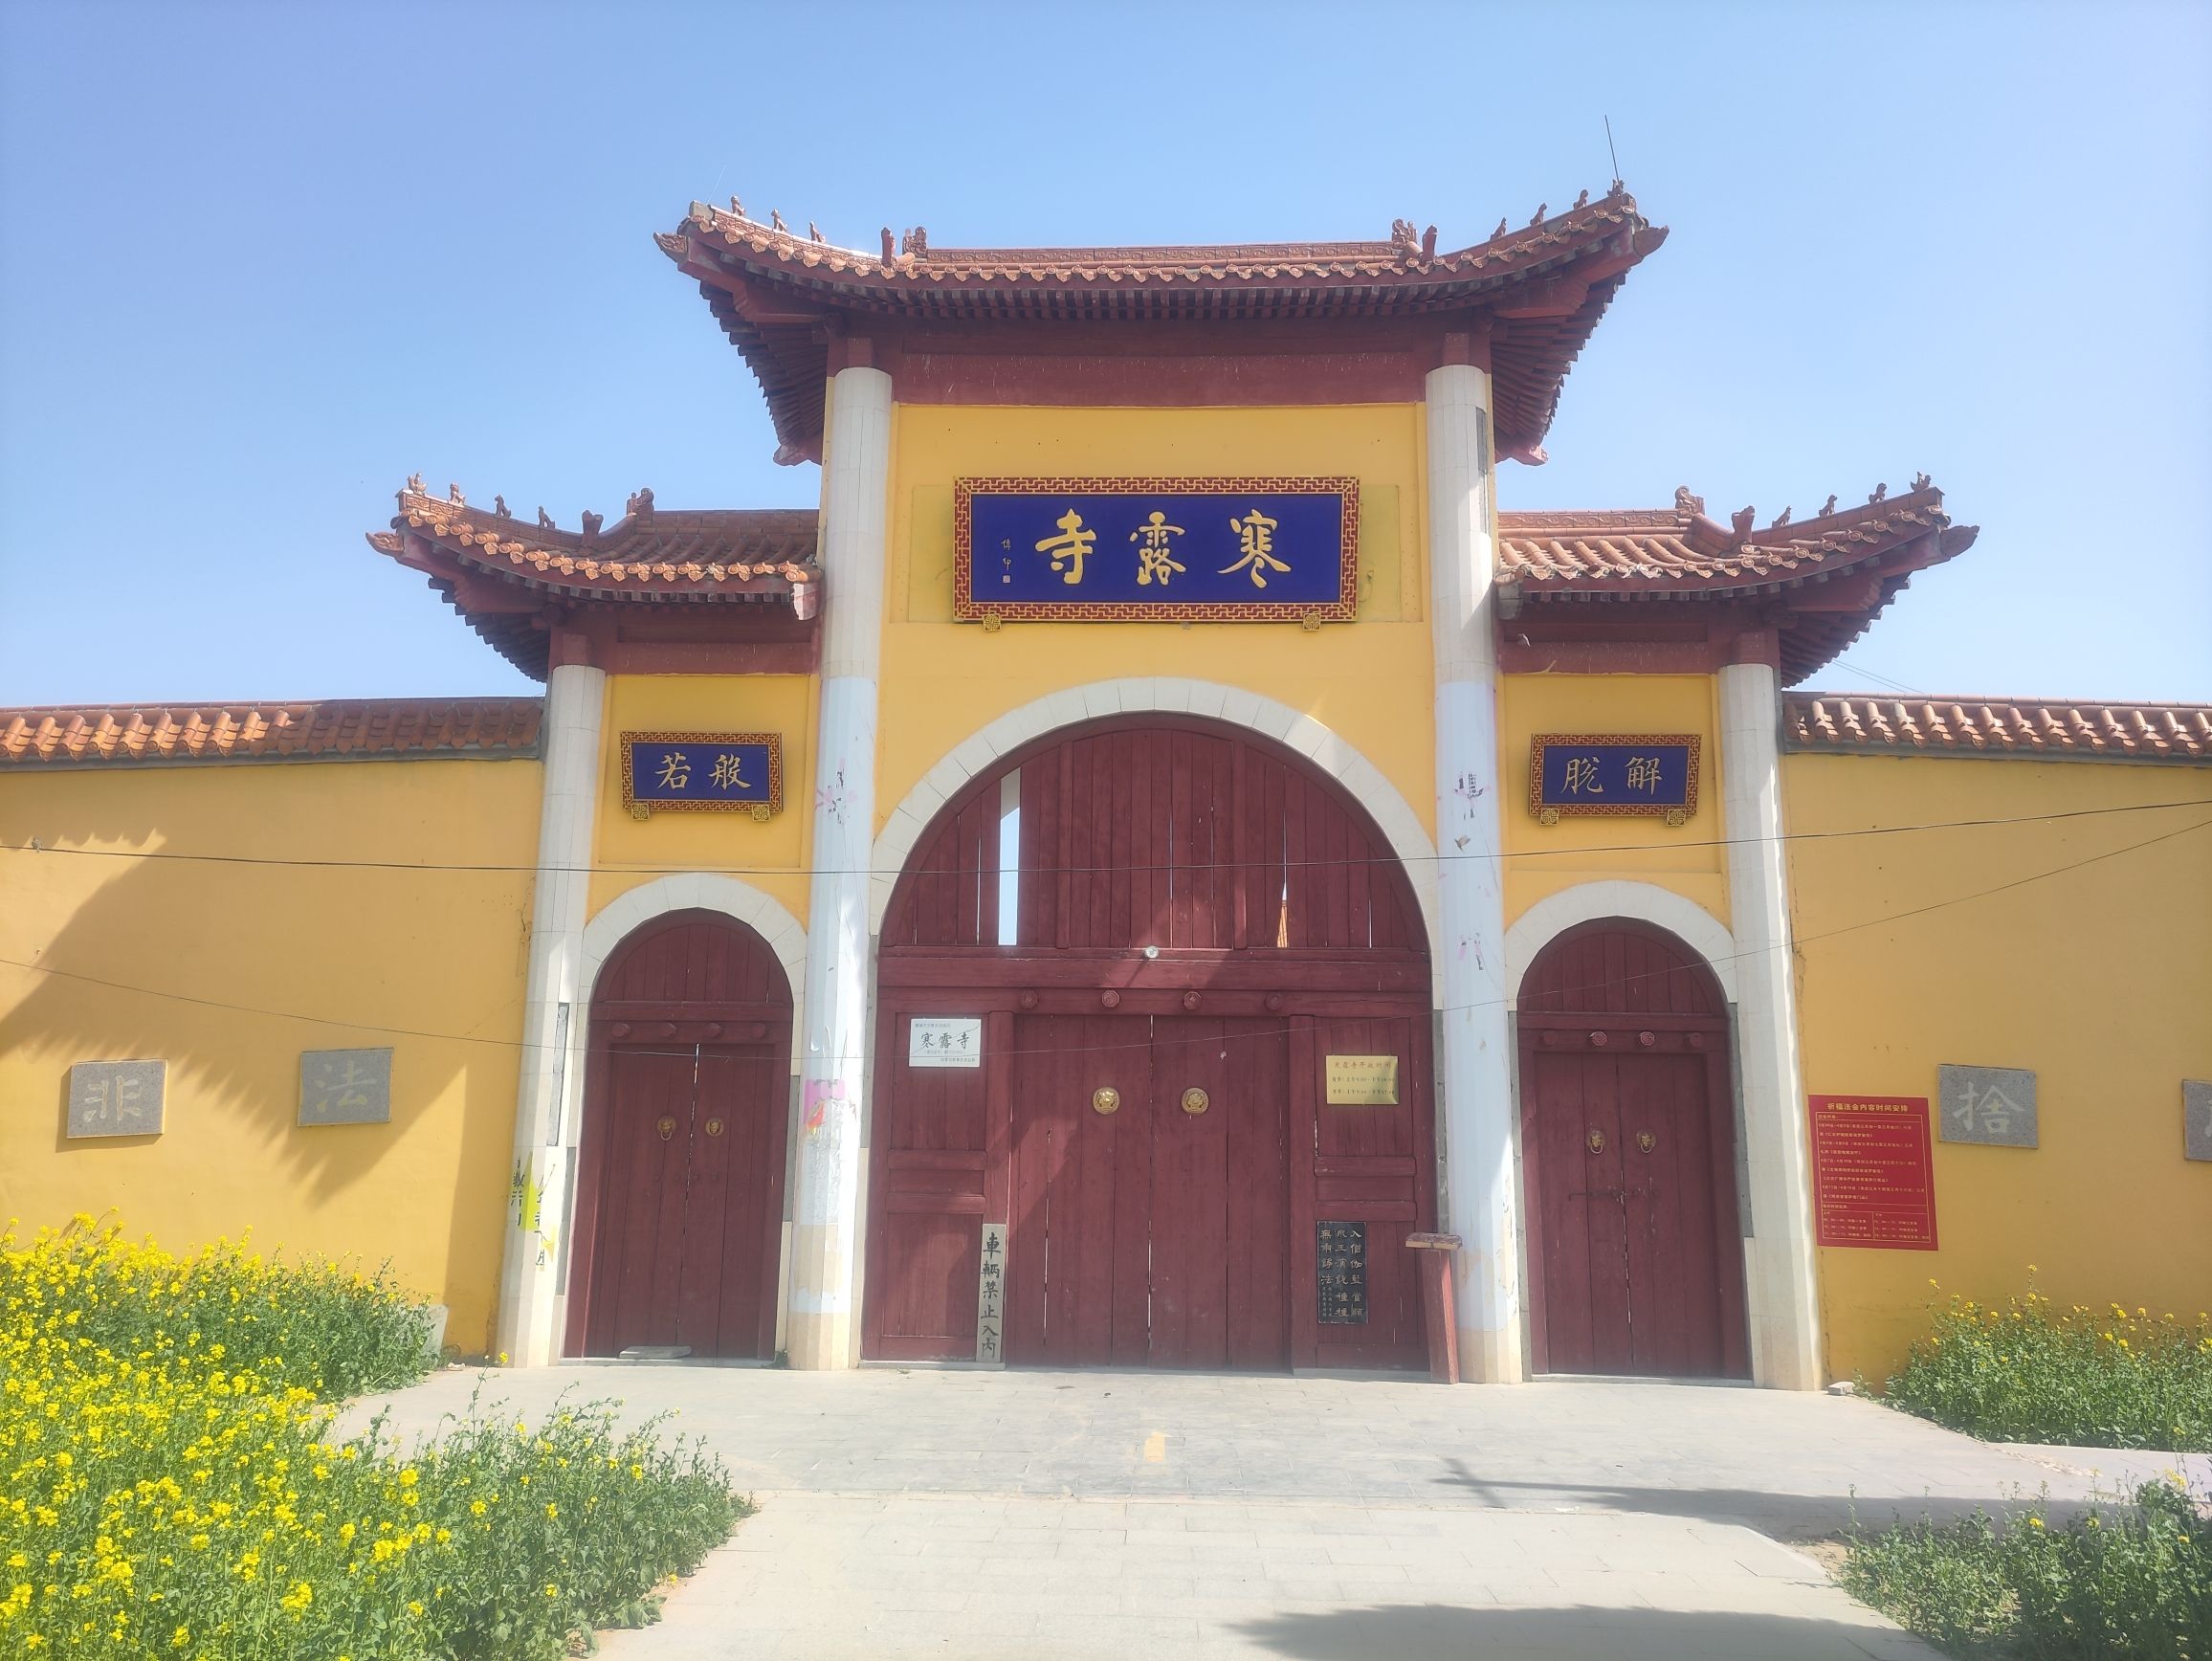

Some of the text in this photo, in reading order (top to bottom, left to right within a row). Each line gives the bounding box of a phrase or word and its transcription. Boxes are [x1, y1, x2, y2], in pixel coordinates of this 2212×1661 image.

[1035, 508, 1292, 588] 寒露寺
[654, 752, 752, 790] 般若
[920, 1031, 970, 1051] 寒露寺
[84, 1074, 143, 1125] 非
[313, 1060, 377, 1113] 法
